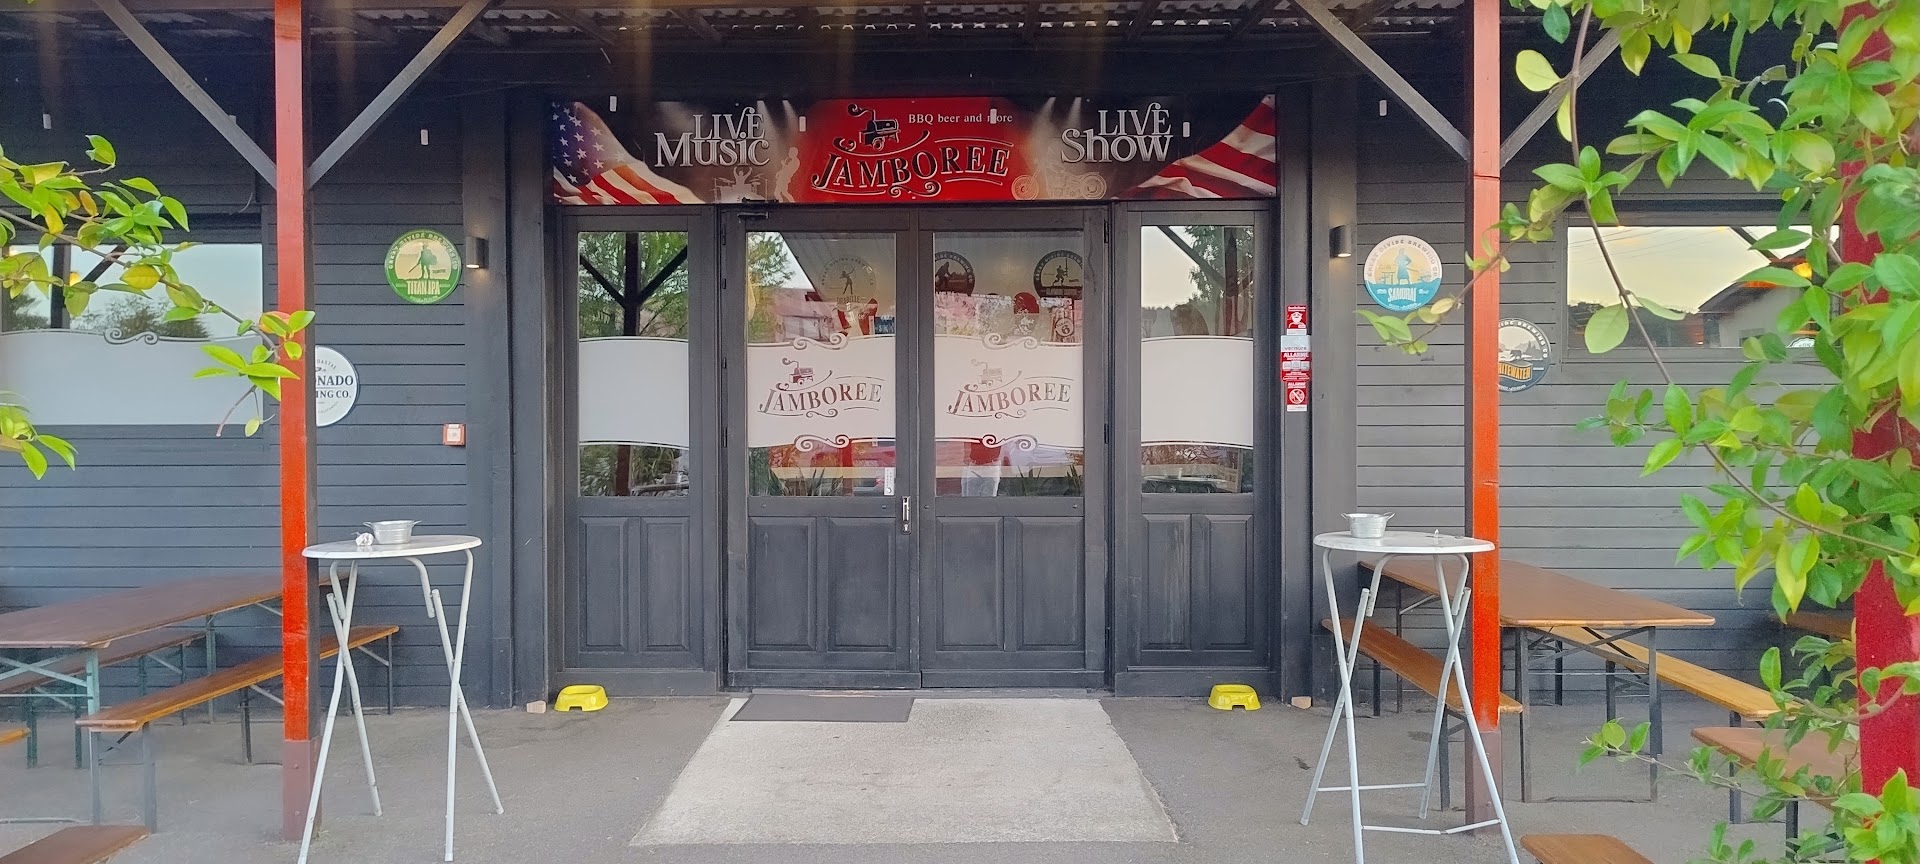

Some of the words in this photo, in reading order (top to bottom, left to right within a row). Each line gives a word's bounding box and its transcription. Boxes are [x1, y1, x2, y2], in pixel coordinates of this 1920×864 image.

[693, 107, 765, 139] LIVE
[908, 113, 934, 125] BBQ
[938, 113, 960, 123] beer
[964, 113, 982, 123] and
[1098, 102, 1171, 135] LIVE
[654, 131, 770, 167] Music
[1061, 128, 1173, 162] Show
[811, 145, 1011, 189] JAMBOREE
[407, 281, 426, 295] TITAN
[427, 281, 441, 295] IPA
[1387, 287, 1417, 303] SAMURAI
[317, 359, 337, 370] OASTAL
[1498, 363, 1531, 379] HITEWATER
[316, 375, 354, 386] NADO
[316, 390, 334, 398] ING
[336, 390, 352, 398] CO.
[759, 382, 882, 413] JAMBOREE
[948, 382, 1071, 414] JAMBOREE
